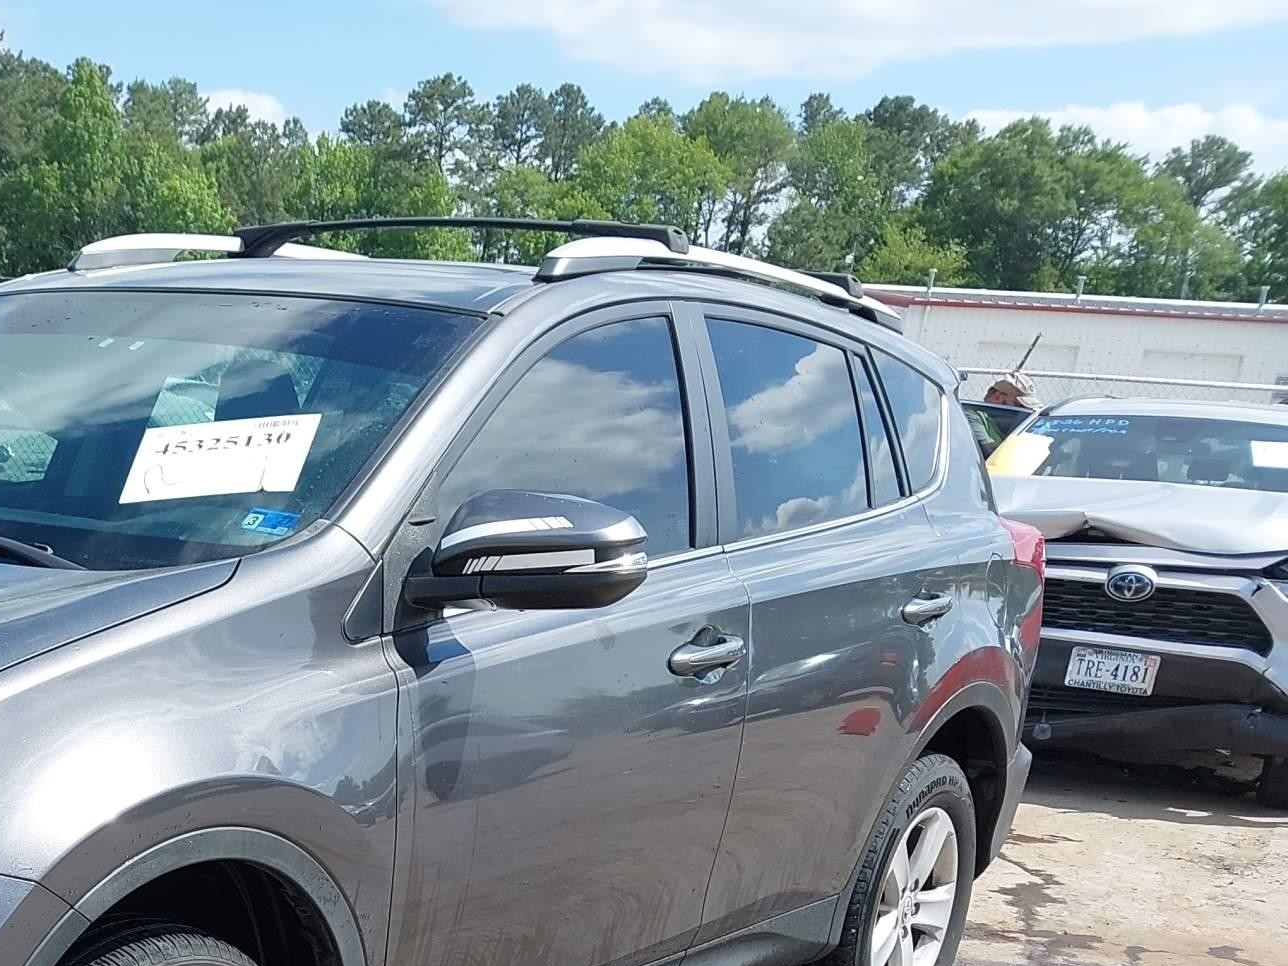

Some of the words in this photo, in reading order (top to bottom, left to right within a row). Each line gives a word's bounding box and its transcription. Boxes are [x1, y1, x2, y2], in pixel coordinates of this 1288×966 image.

[154, 429, 292, 456] 45325130
[247, 515, 260, 526] 3
[1094, 651, 1136, 664] VIRGINIA
[1075, 658, 1149, 684] TRE-4181
[1067, 678, 1114, 692] CHANTILLY
[1116, 684, 1149, 696] TOYOTA
